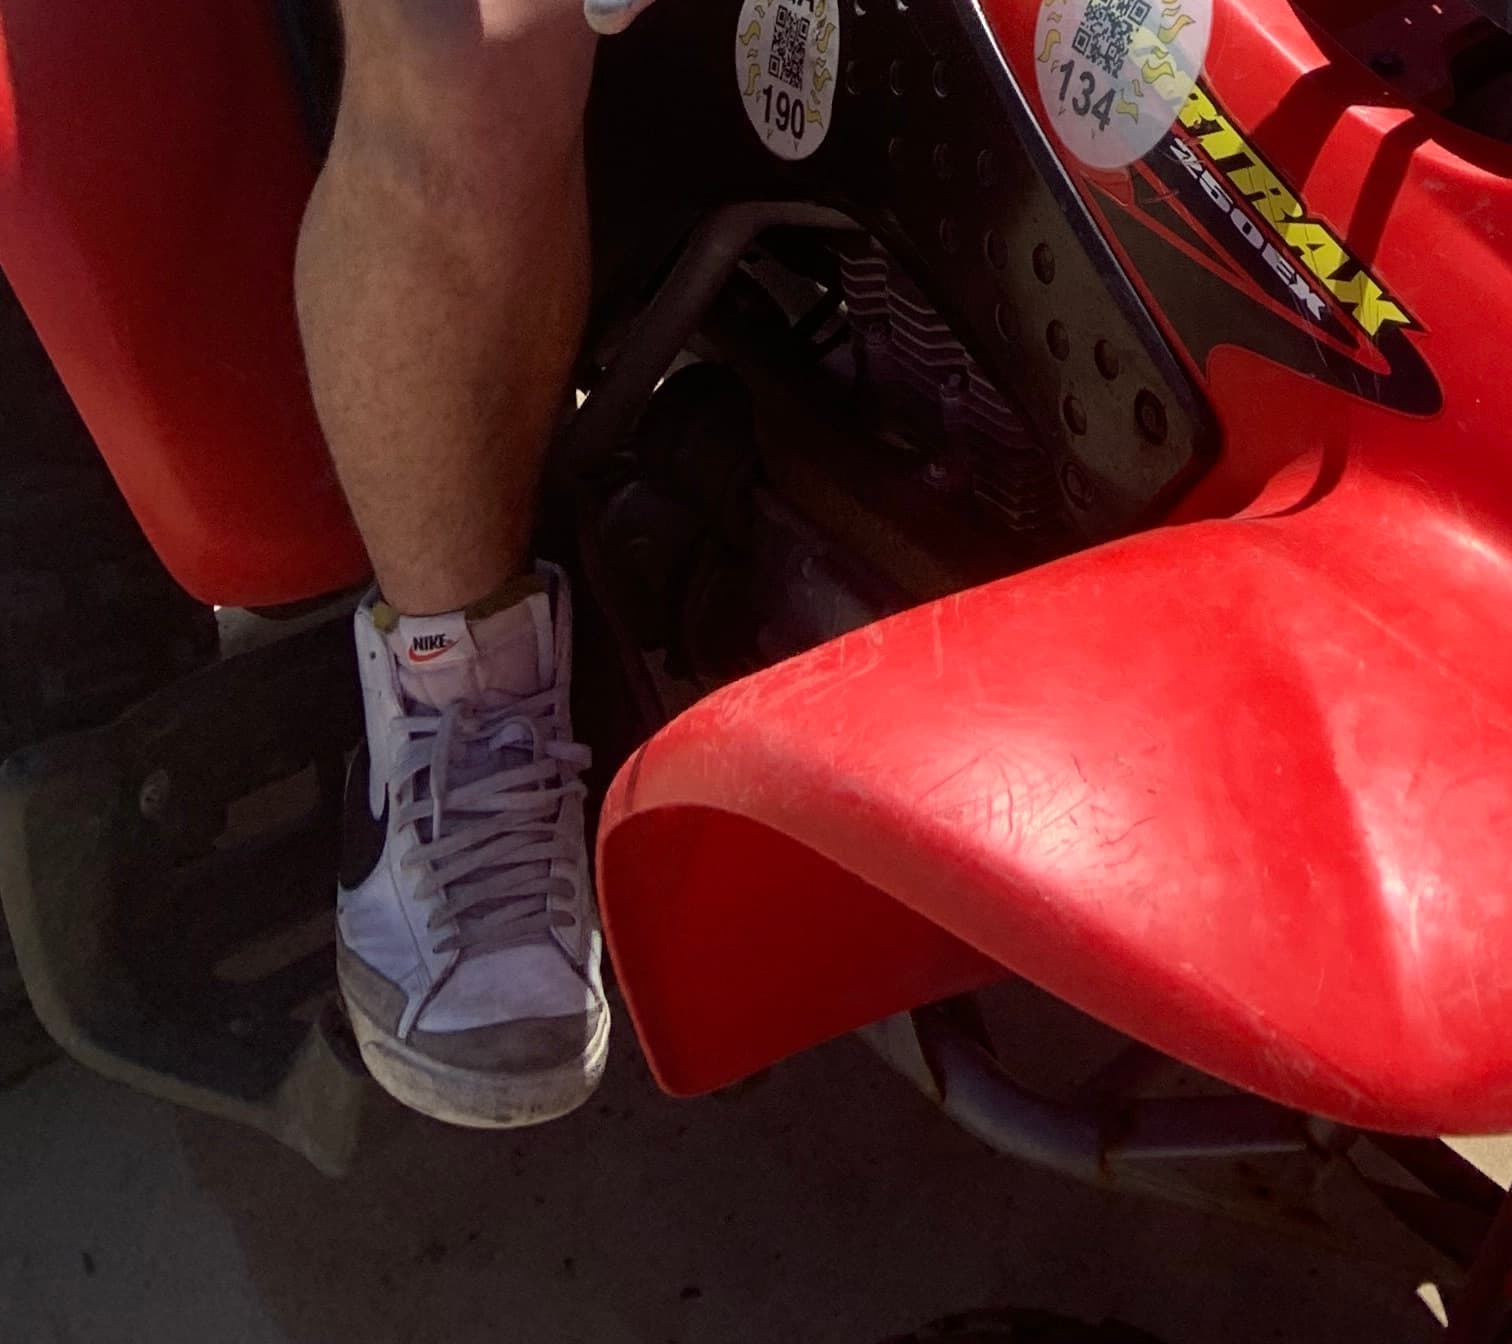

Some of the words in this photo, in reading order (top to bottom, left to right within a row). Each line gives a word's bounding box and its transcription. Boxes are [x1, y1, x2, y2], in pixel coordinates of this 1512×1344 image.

[762, 83, 806, 140] 190
[1058, 60, 1117, 132] 134
[1168, 137, 1327, 321] 250EX
[413, 633, 447, 651] NIKE
